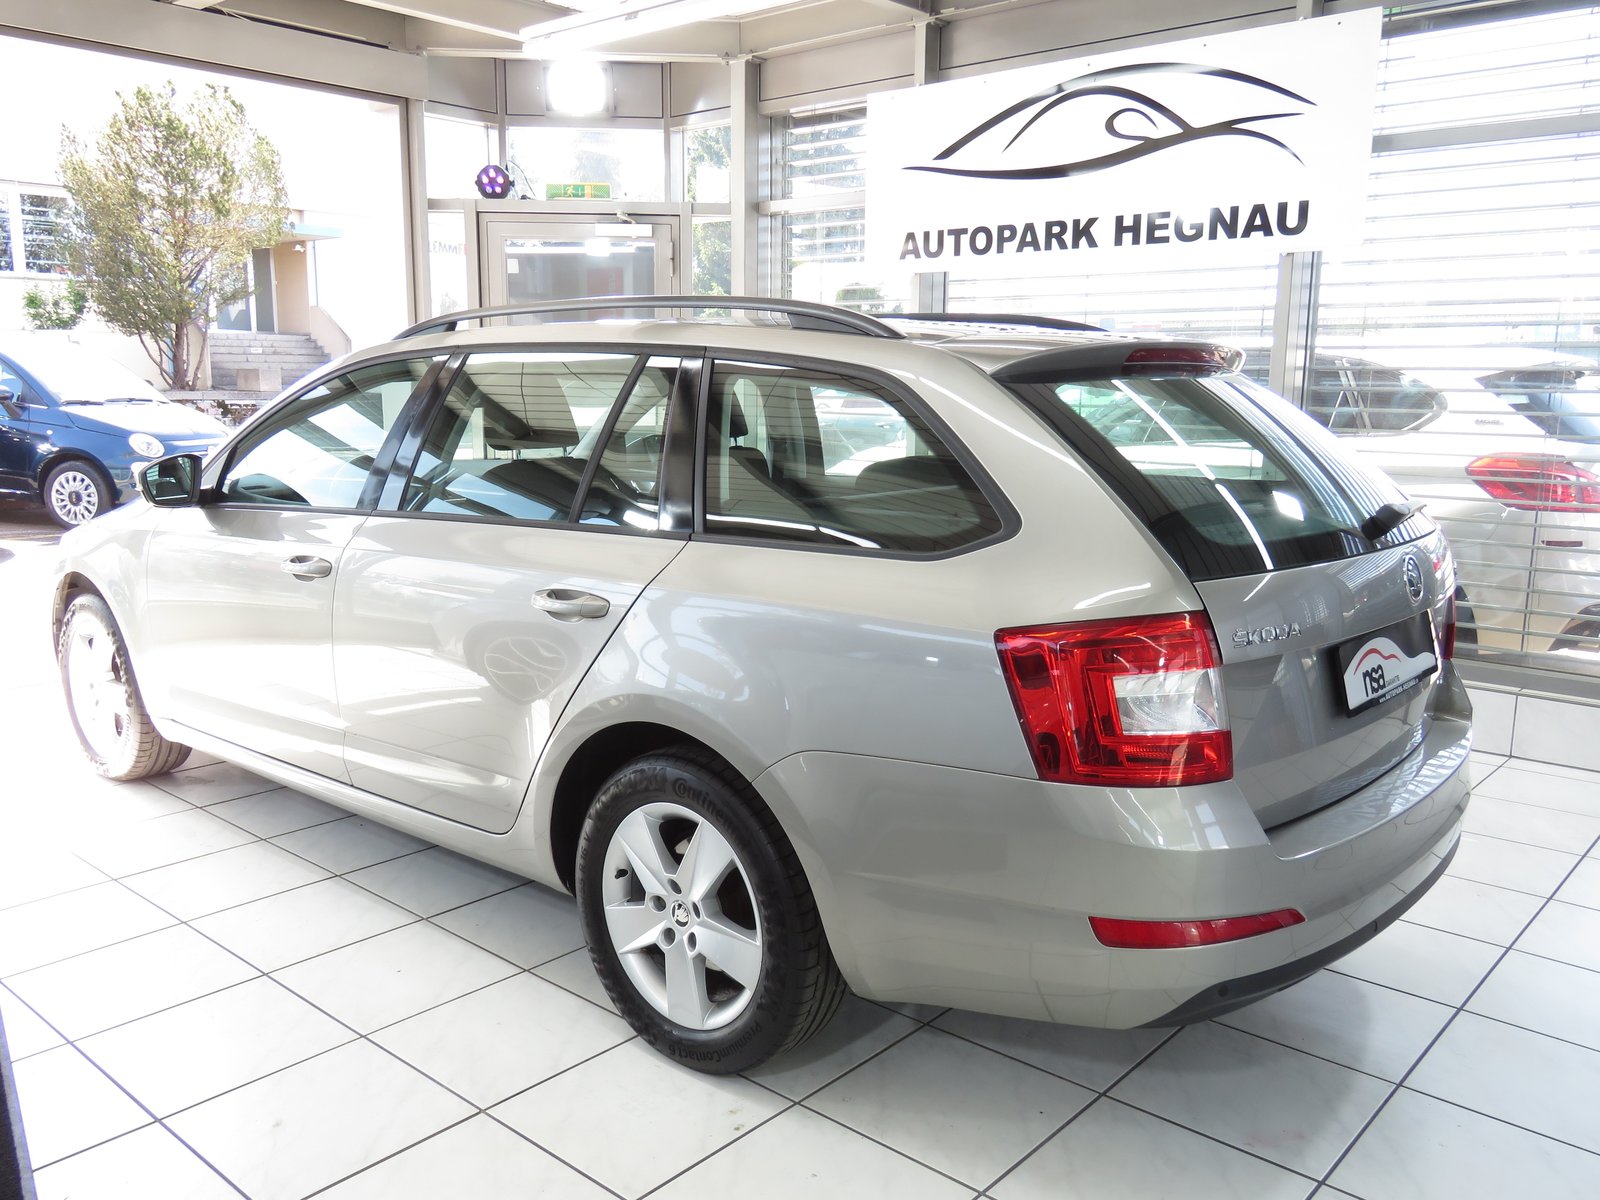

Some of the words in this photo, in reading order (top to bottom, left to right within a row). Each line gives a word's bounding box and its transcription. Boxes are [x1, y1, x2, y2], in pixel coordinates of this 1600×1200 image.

[899, 216, 1099, 260] AUTOPARK
[1114, 199, 1310, 246] HEGNAU
[1232, 622, 1302, 649] ŠKODA
[1362, 664, 1386, 698] nsa
